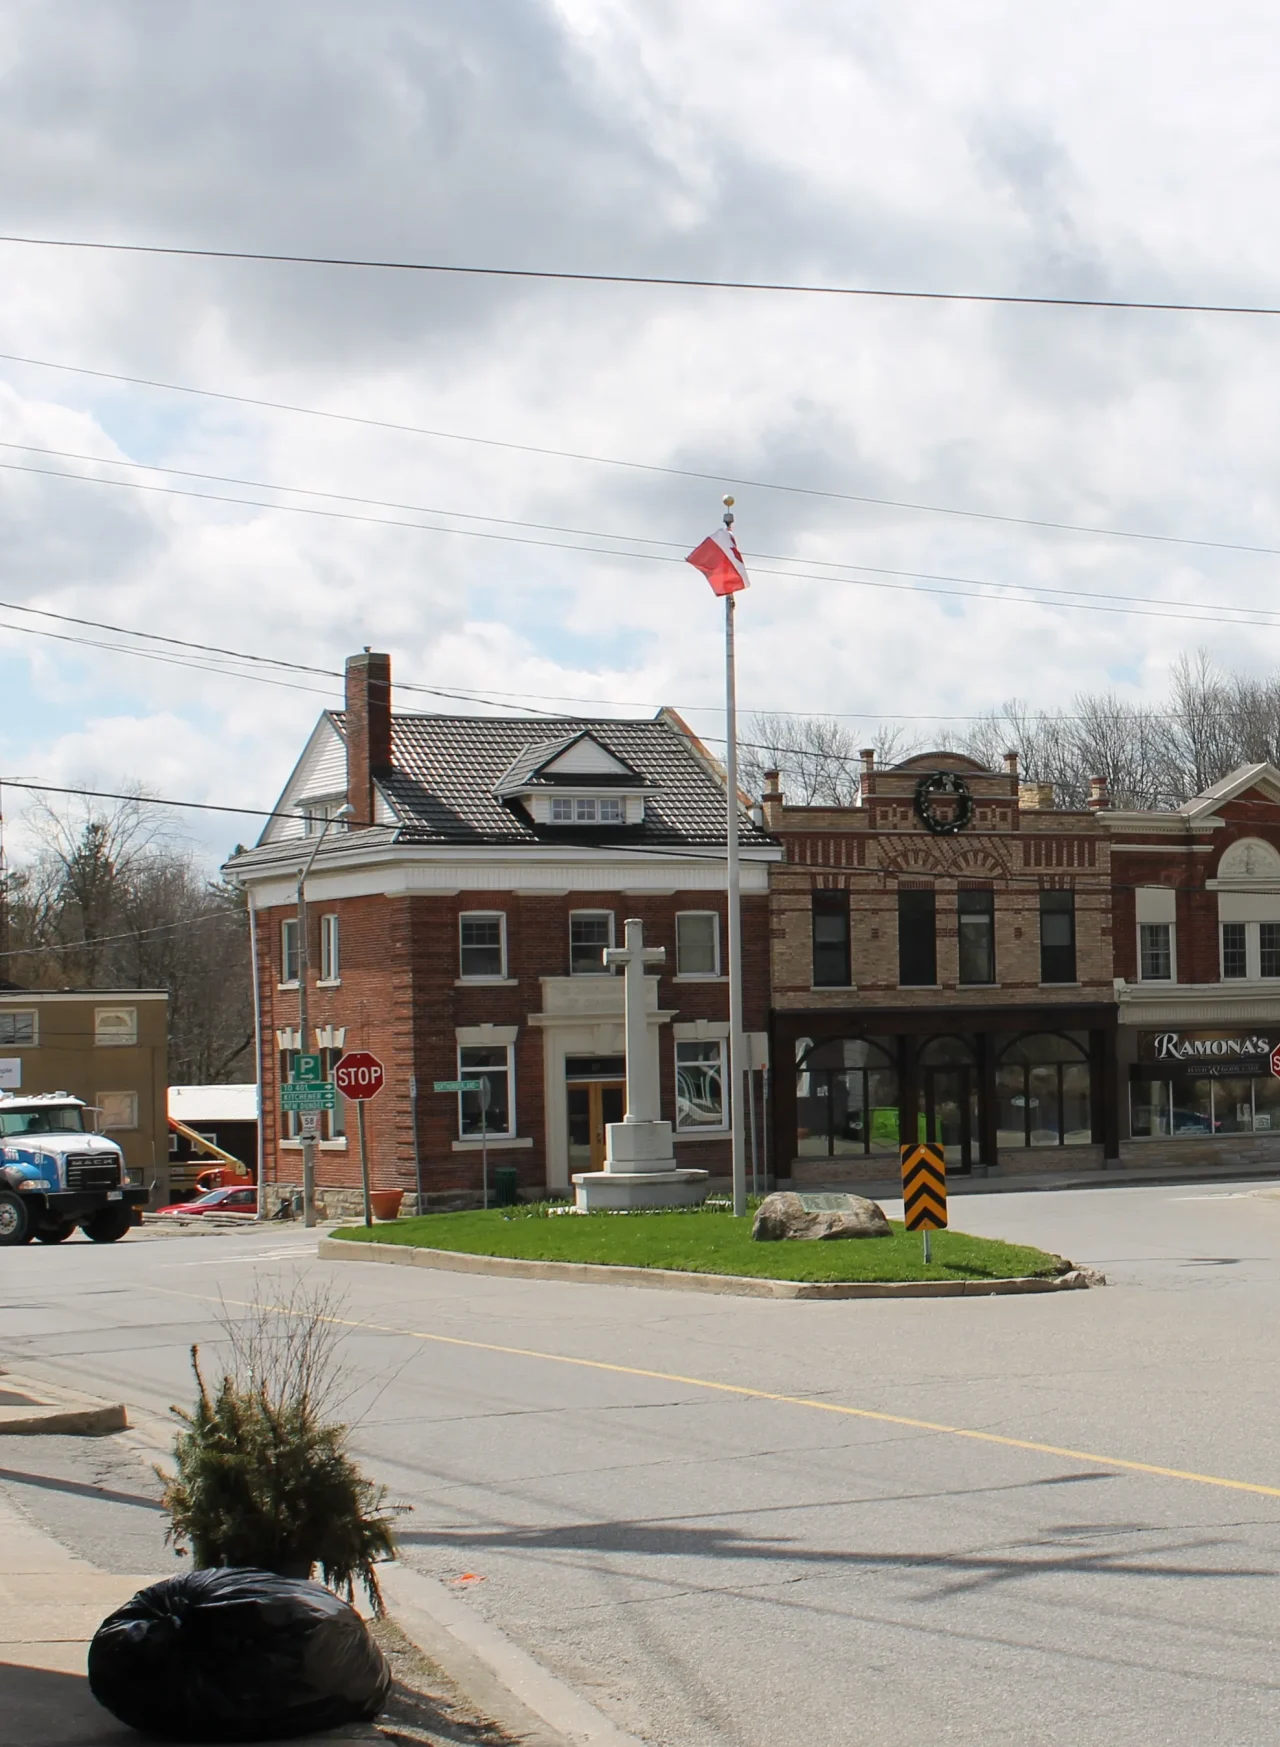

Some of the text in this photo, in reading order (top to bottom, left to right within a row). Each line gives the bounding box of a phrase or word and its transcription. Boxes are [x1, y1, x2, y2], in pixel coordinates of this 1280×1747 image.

[1154, 1033, 1270, 1060] RAMONA'S
[301, 1058, 315, 1073] P
[338, 1066, 381, 1086] STOP
[284, 1093, 321, 1101] KITCHENER
[304, 1117, 315, 1126] 58
